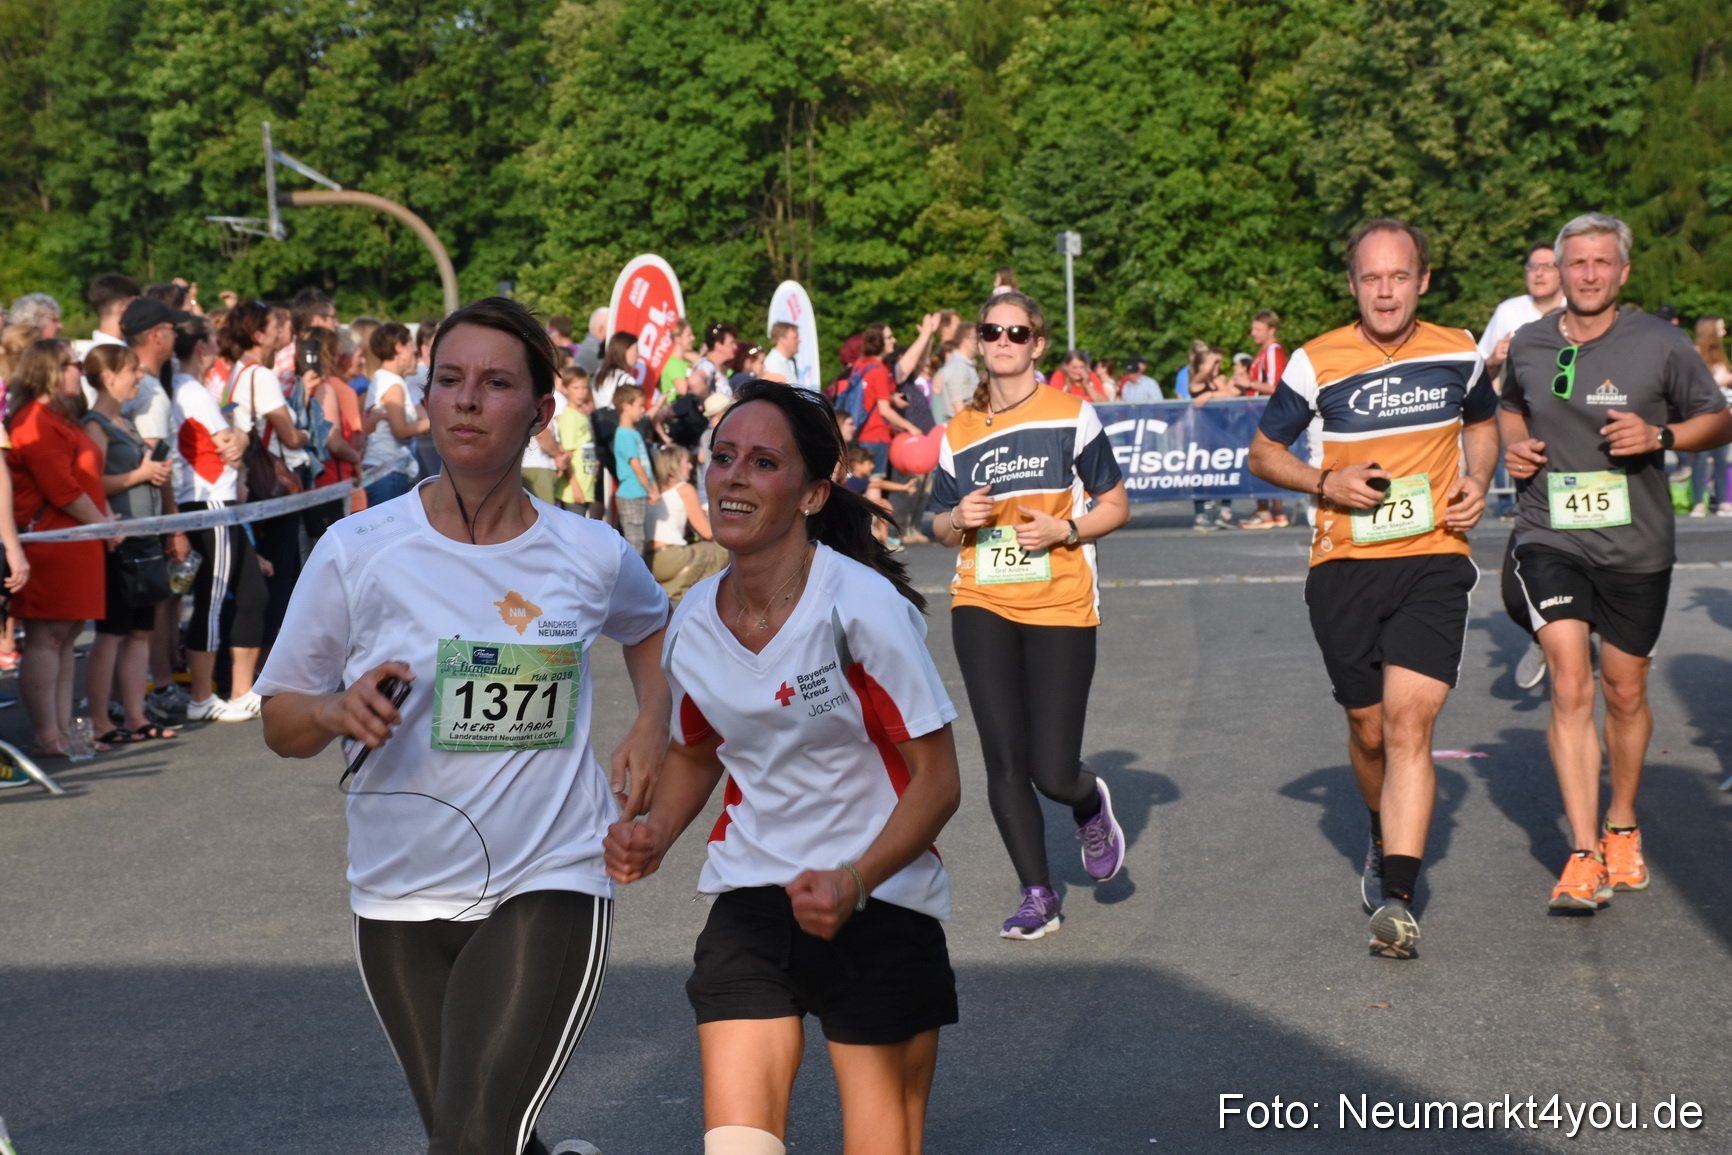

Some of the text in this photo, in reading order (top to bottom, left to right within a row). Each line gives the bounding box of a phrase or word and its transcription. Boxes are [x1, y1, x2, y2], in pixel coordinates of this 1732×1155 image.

[1368, 385, 1449, 410] Fischer
[1377, 401, 1447, 418] AUTOMOBILE
[1112, 441, 1250, 474] Fischer
[985, 454, 1049, 480] Fischer
[990, 469, 1044, 485] AUTOMOBILE
[1124, 472, 1241, 490] AUTOMOBILE
[1565, 492, 1610, 513] 415
[990, 545, 1031, 568] 752
[509, 607, 527, 617] NM
[538, 620, 577, 629] LANDKREIS
[538, 628, 578, 637] NEUMARKT
[460, 661, 521, 675] firmenlauf
[550, 671, 573, 682] 2019
[800, 677, 827, 692] Rotes
[454, 680, 559, 721] 1371
[802, 685, 830, 701] Kreuz
[508, 720, 553, 733] MARIA
[449, 732, 497, 741] Landratsamt
[499, 732, 533, 742] Neumarkt
